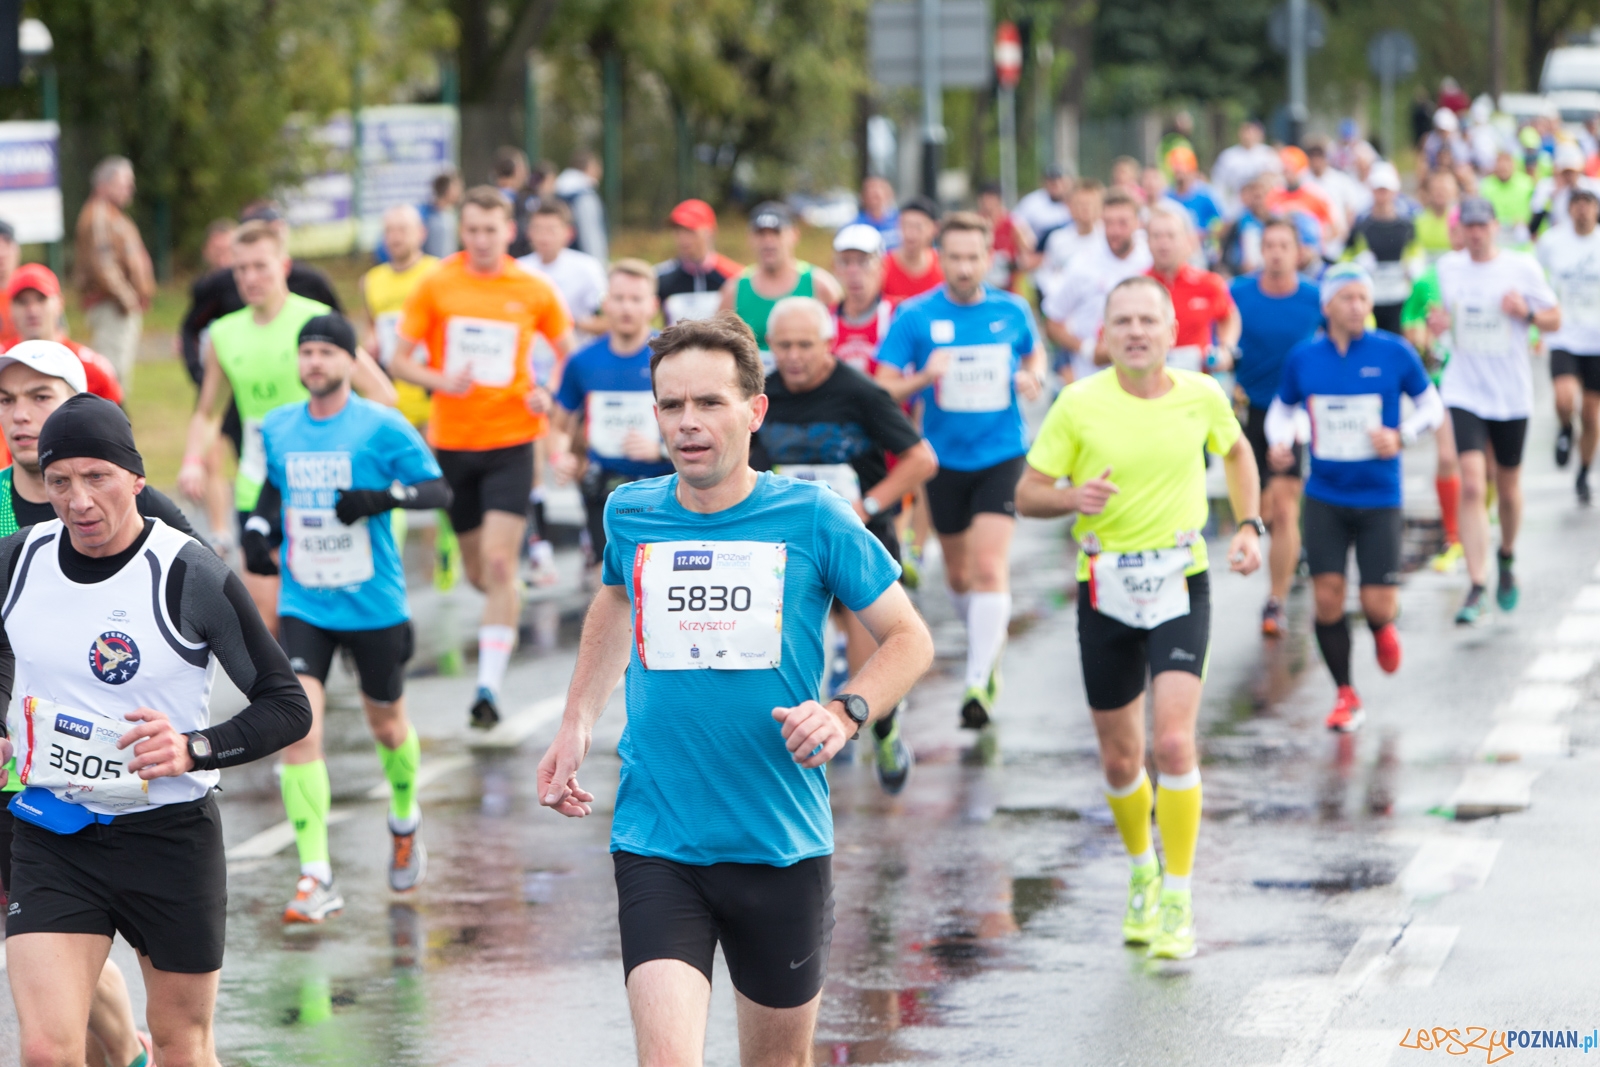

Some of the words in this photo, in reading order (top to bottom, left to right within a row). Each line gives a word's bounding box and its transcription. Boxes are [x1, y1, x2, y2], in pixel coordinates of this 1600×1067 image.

[676, 555, 710, 566] 17.PKO
[667, 585, 752, 612] 5830
[679, 620, 737, 632] Krzysztof
[105, 632, 132, 644] FENIX
[58, 719, 90, 735] 17.PKO
[49, 743, 123, 780] 3505
